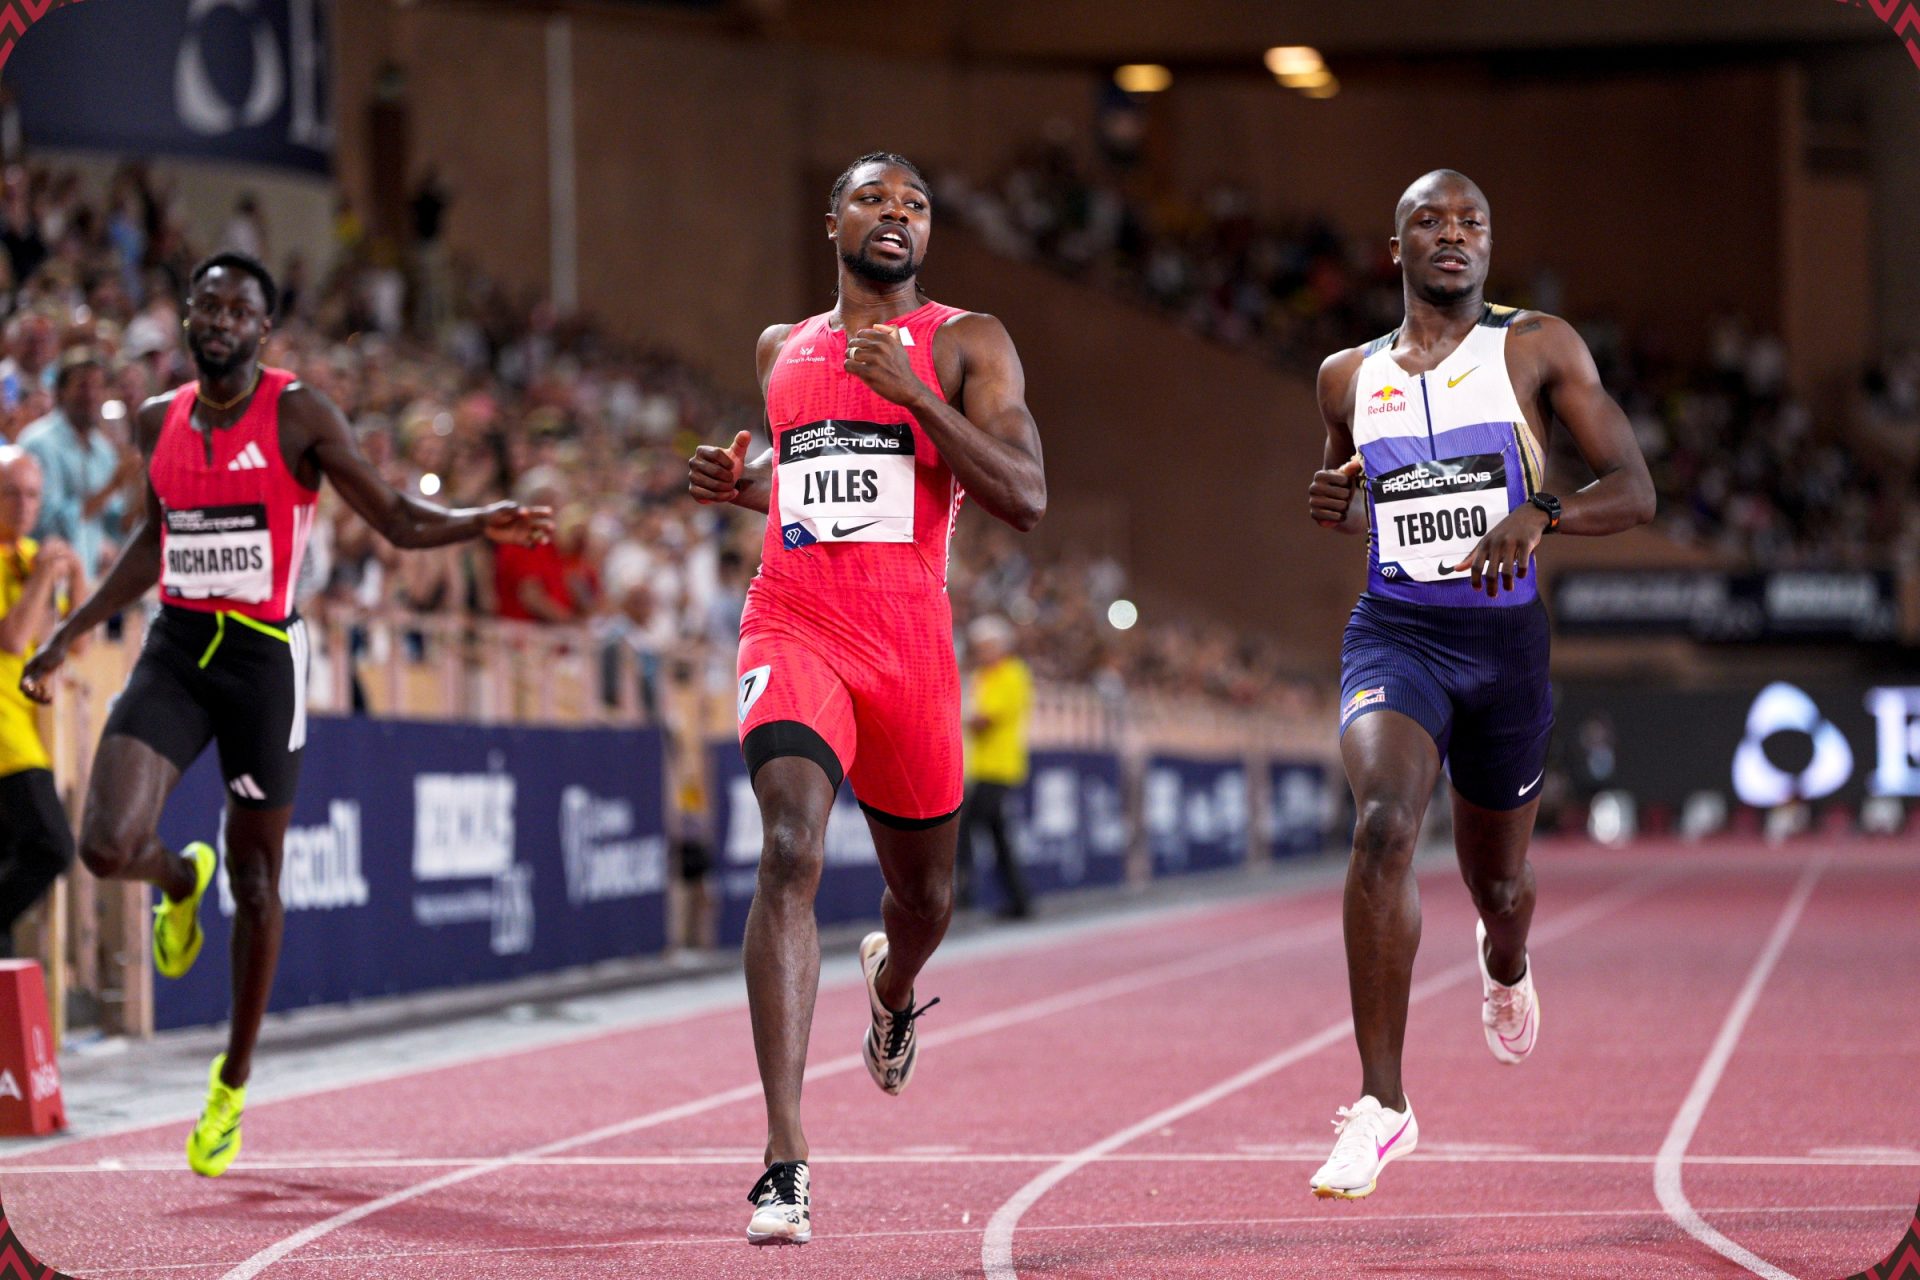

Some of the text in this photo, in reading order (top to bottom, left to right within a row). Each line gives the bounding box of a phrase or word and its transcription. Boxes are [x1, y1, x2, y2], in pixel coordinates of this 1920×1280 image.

[1367, 401, 1406, 416] Red Bull
[790, 426, 836, 445] ICONIC
[790, 437, 900, 456] PRODUCTIONS
[803, 469, 878, 505] LYLES
[1382, 471, 1492, 494] PRODUCTIONS
[1394, 505, 1488, 547] TEBOGO
[168, 545, 263, 574] RICHARDS
[744, 675, 757, 703] 7
